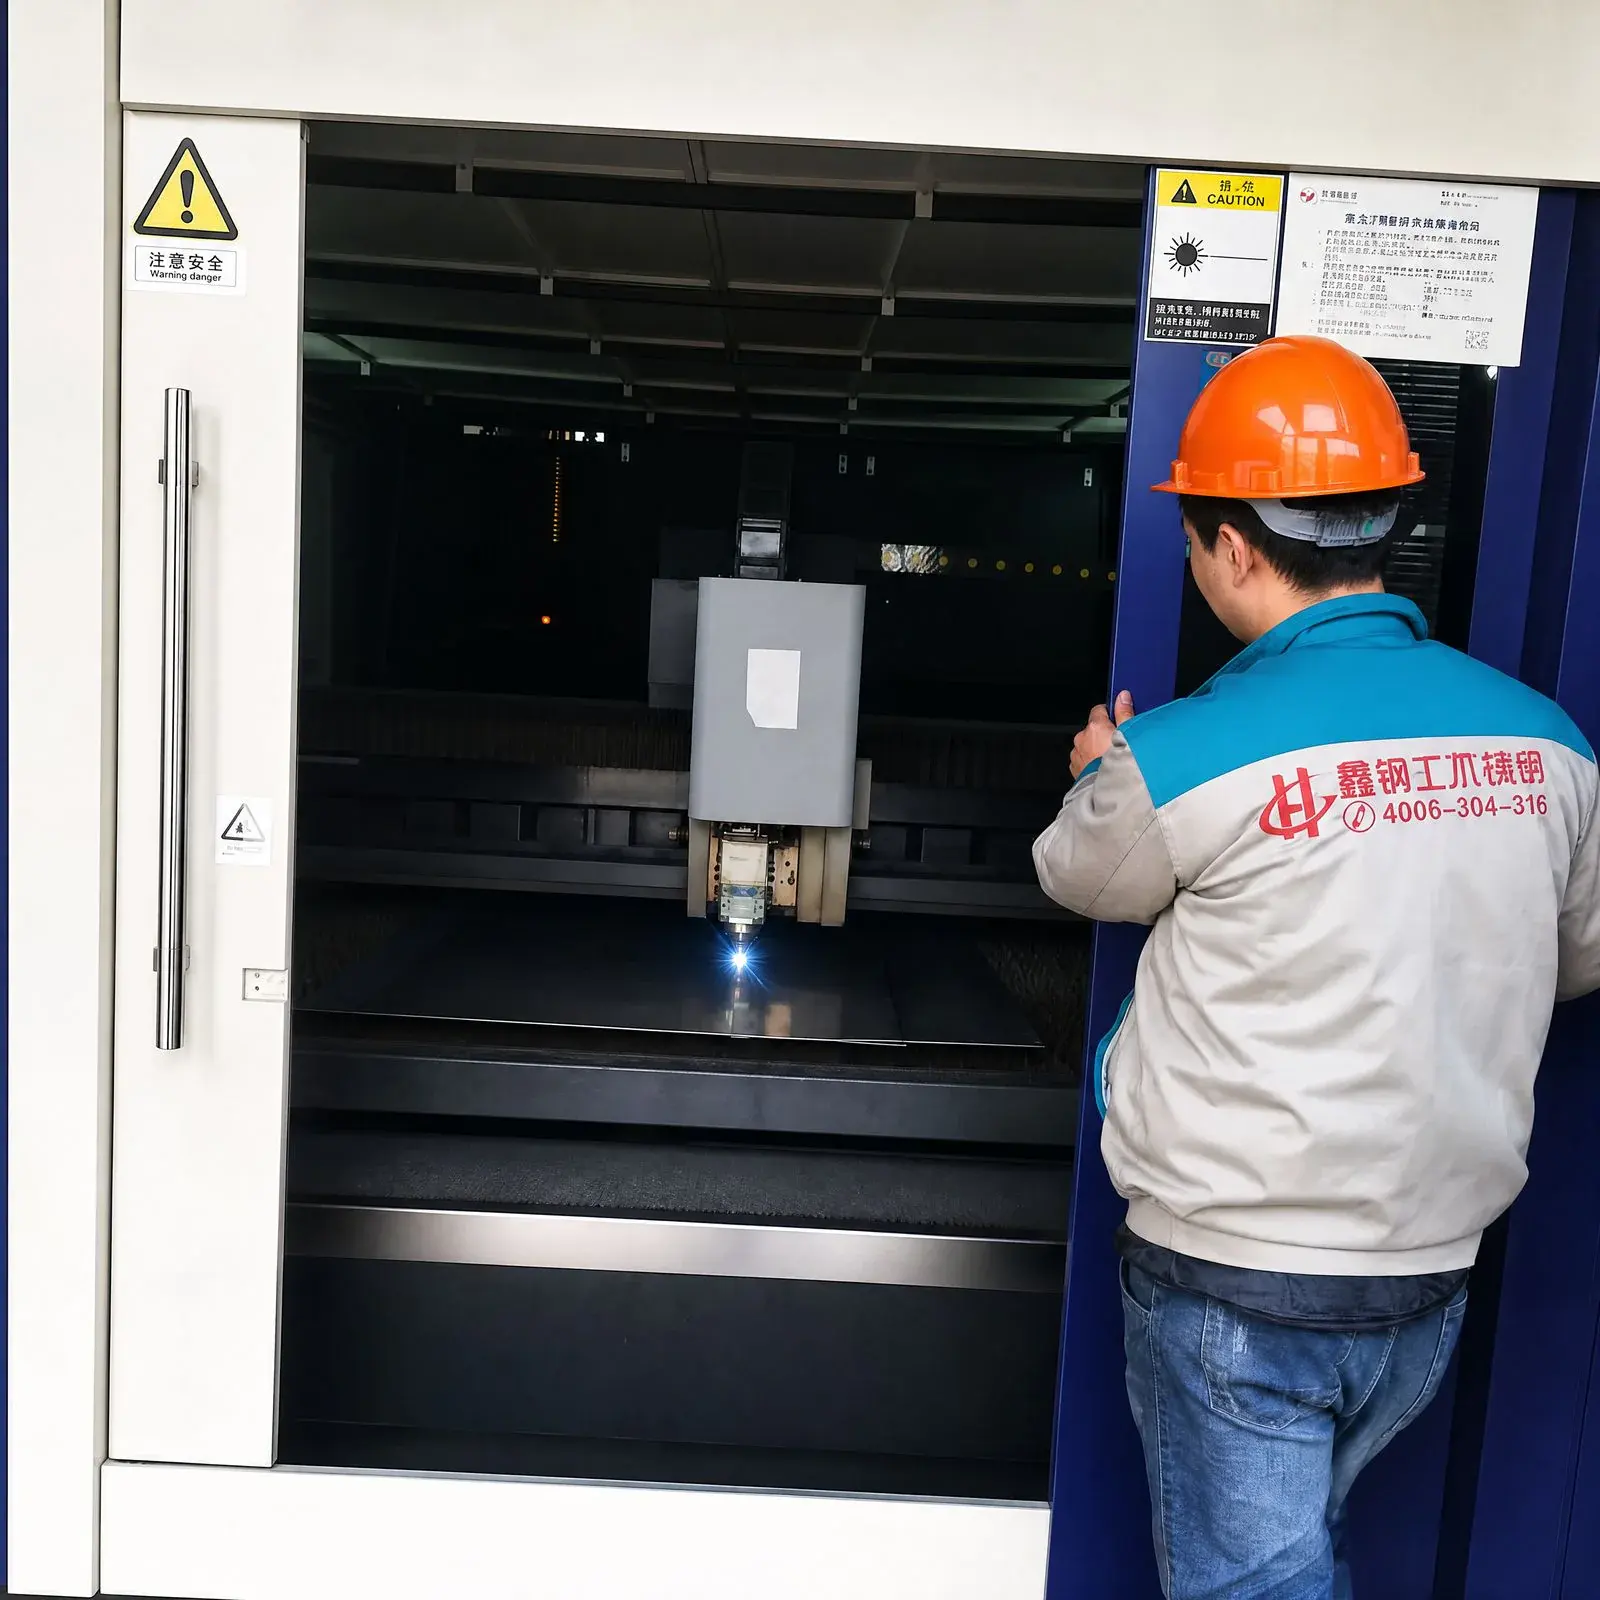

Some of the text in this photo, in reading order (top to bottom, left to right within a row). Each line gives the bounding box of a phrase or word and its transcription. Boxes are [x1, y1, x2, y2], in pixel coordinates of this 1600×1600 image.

[1207, 194, 1265, 206] CAUTION
[149, 251, 223, 272] 注意安全
[150, 269, 222, 283] Warning danger
[1382, 793, 1548, 824] 4006-304-316
